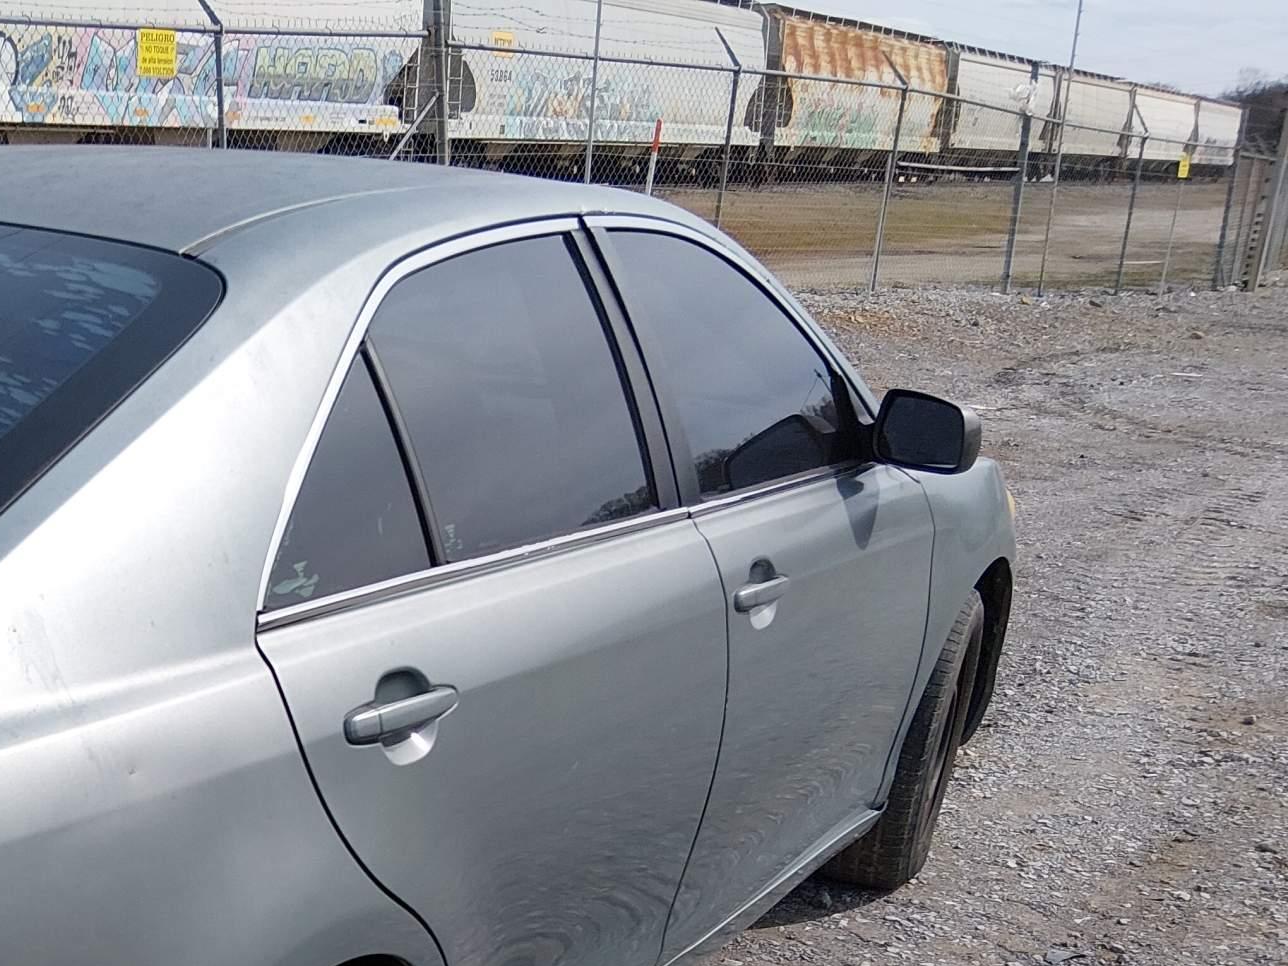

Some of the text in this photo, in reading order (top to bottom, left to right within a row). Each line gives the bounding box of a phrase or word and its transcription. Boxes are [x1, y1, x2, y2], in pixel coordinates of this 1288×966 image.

[140, 32, 175, 43] PELIGRO
[145, 45, 169, 54] NO TOQUE
